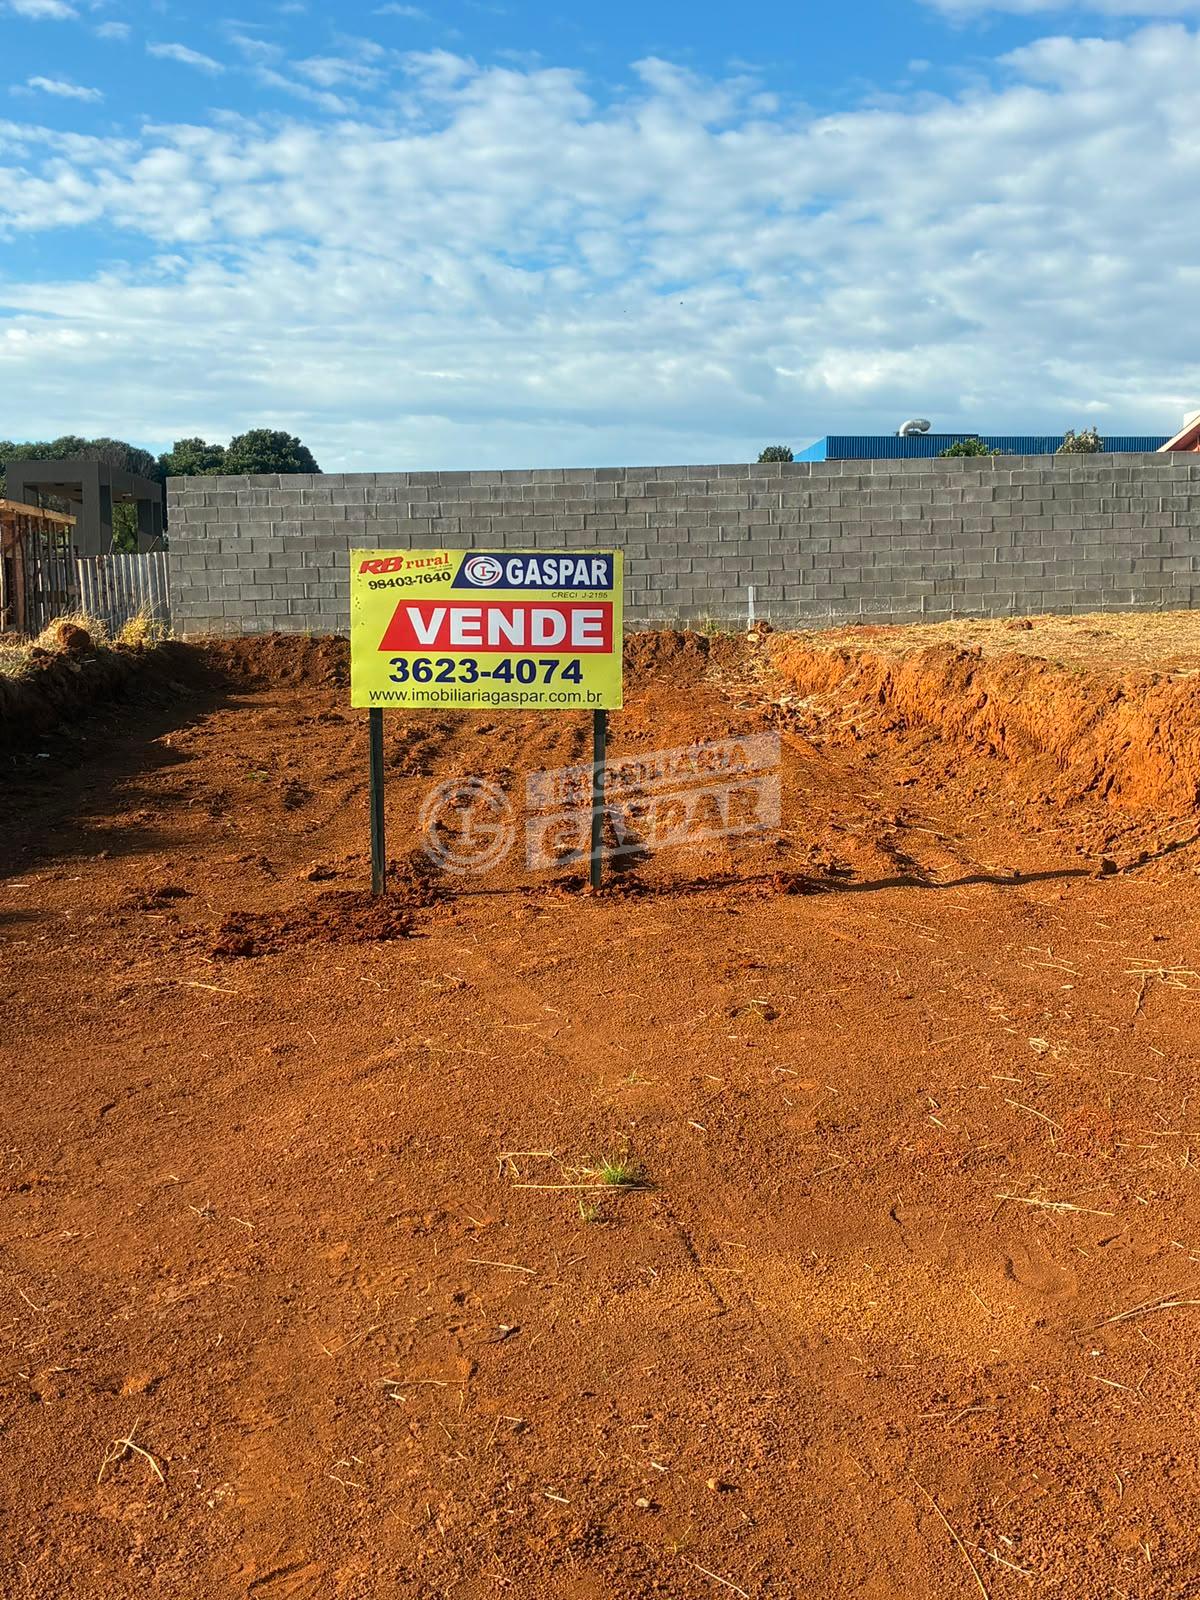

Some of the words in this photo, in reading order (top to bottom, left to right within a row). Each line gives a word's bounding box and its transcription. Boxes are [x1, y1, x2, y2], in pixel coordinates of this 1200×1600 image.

[359, 556, 404, 575] RB
[405, 553, 449, 570] rural
[505, 558, 608, 586] GASPAR
[368, 571, 452, 591] 98403-7640
[551, 591, 578, 599] CRECI
[406, 607, 604, 646] VENDE
[388, 657, 584, 684] 3623-4074
[369, 688, 603, 704] www.imobiliariagaspar.com.br
